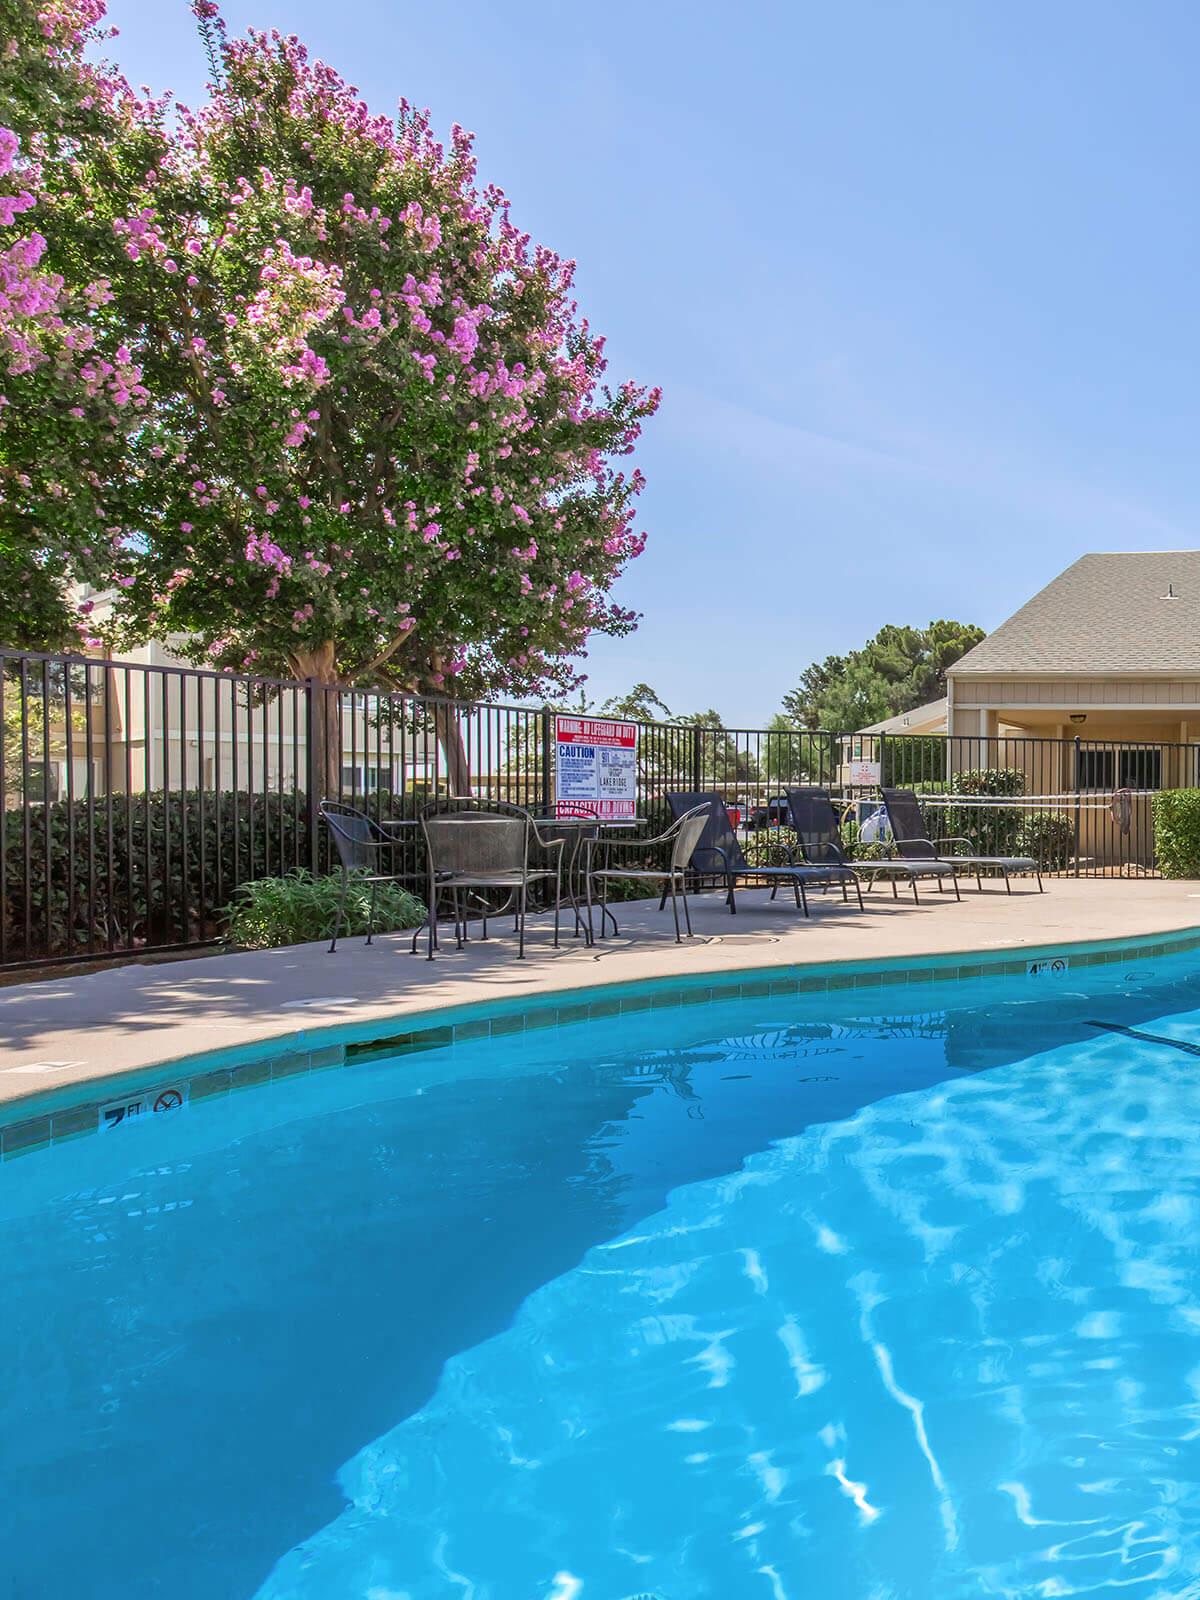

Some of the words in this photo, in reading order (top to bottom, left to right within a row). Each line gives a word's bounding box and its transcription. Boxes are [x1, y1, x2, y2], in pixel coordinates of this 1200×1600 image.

[559, 745, 595, 759] CAUTION
[559, 800, 598, 815] CAPACITY
[127, 1102, 142, 1118] FT
